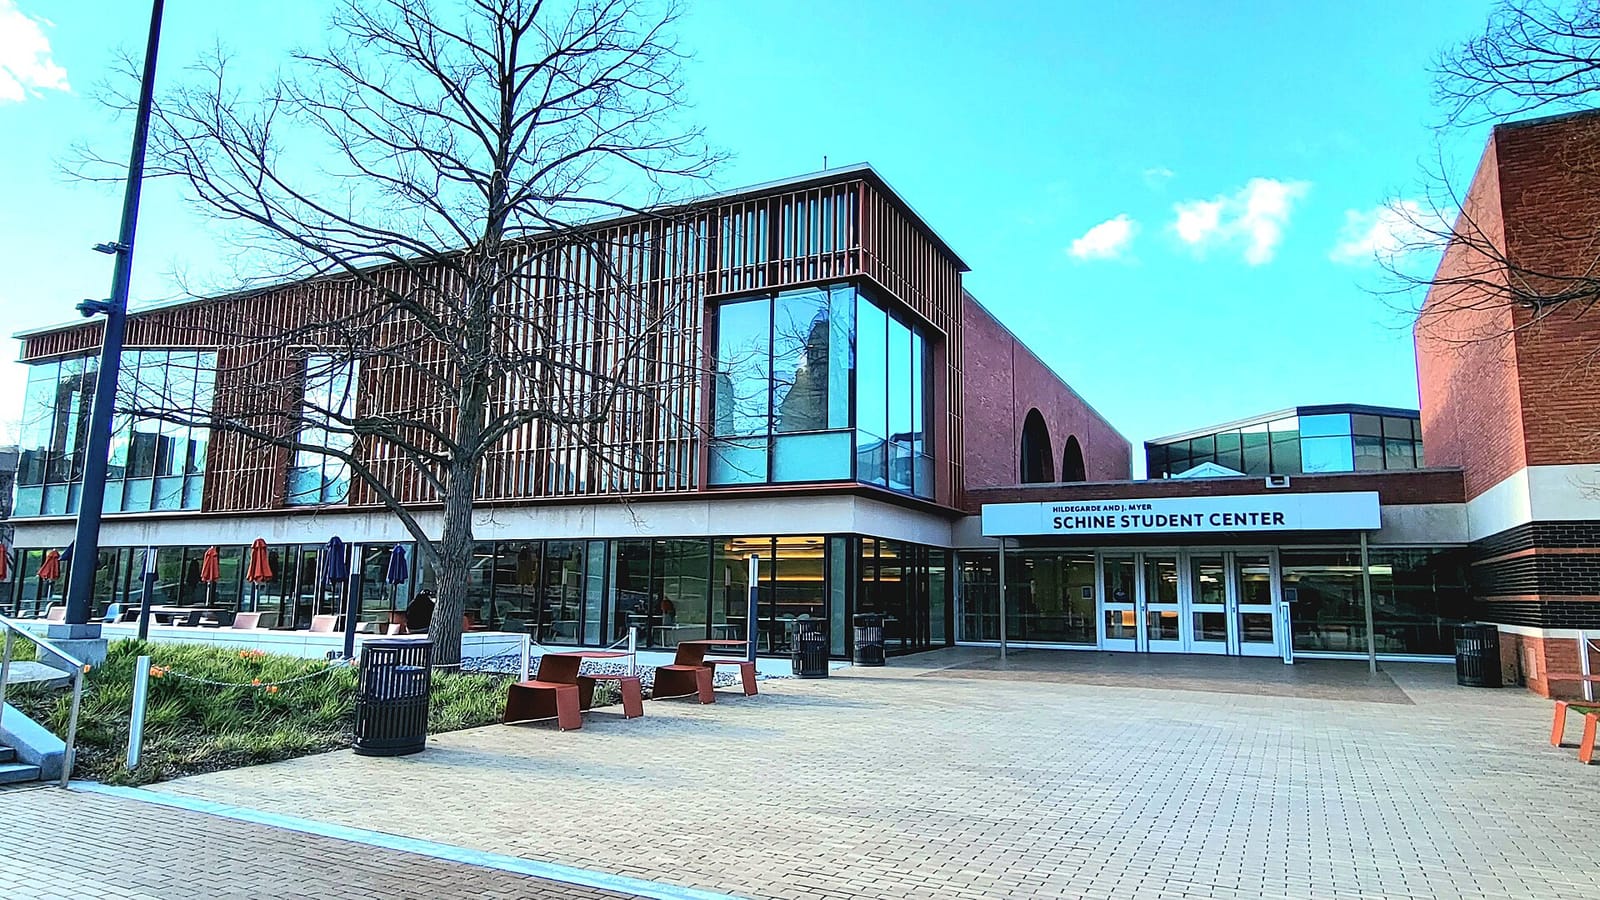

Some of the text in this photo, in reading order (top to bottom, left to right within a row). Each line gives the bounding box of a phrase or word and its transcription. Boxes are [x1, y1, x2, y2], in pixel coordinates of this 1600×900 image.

[1052, 505, 1101, 513] HILDEGARDE
[1053, 512, 1285, 529] SCHINE STUDENT CENTER
